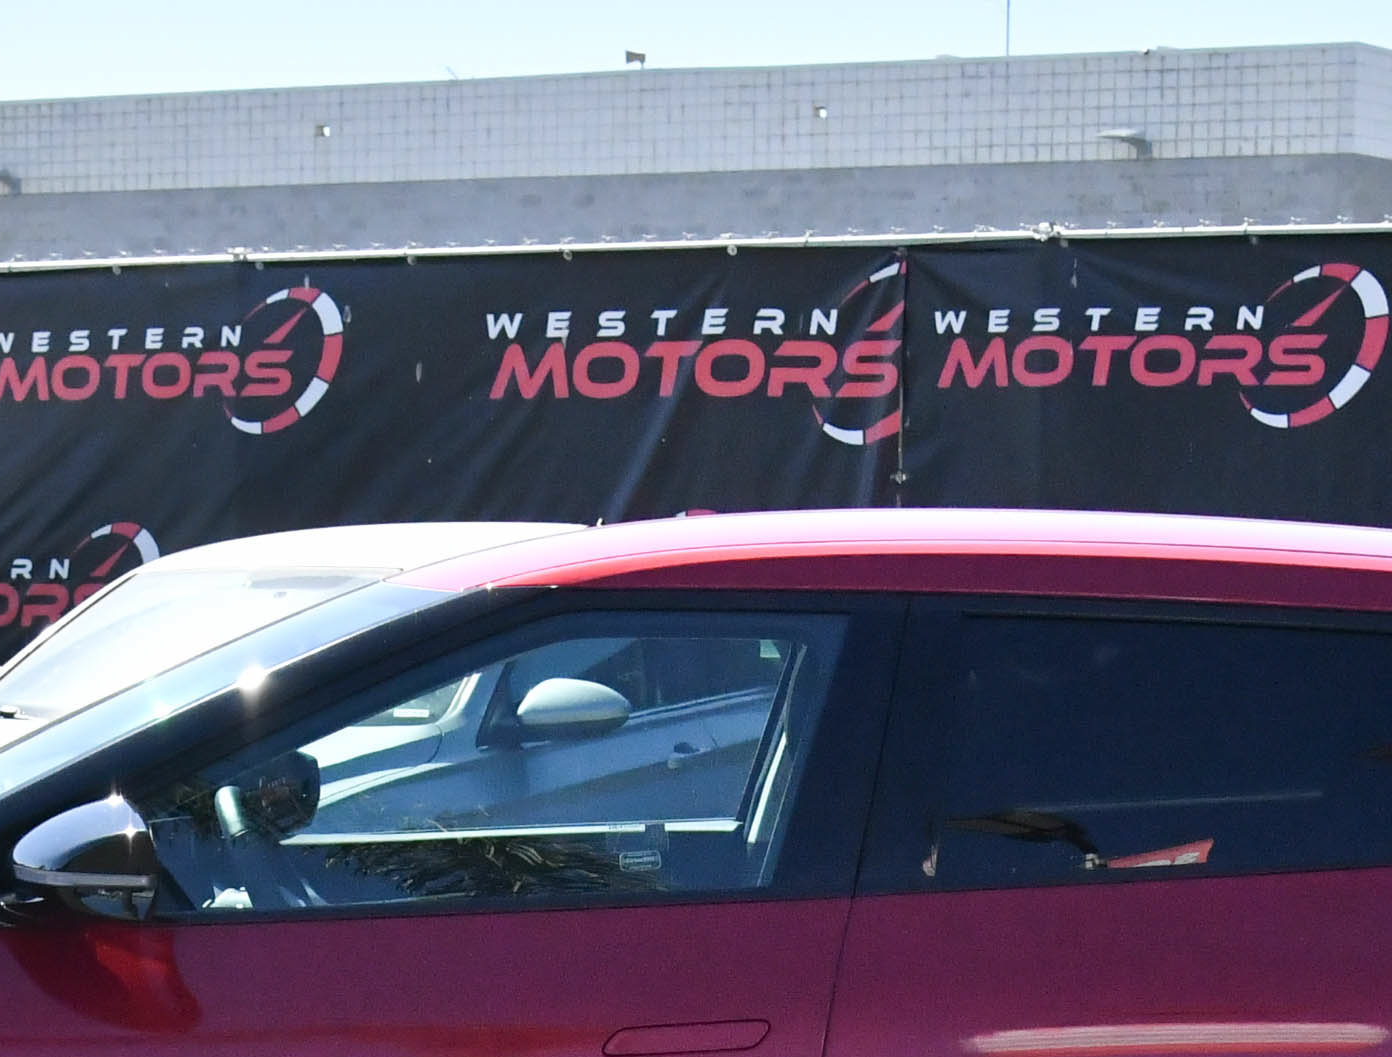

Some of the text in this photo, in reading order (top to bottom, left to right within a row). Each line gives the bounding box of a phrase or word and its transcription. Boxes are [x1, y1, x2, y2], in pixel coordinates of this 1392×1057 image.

[486, 308, 838, 340] WESTERN
[934, 305, 1264, 333] WESTERN
[489, 339, 899, 398] MOTORS
[937, 335, 1326, 388] MOTORS
